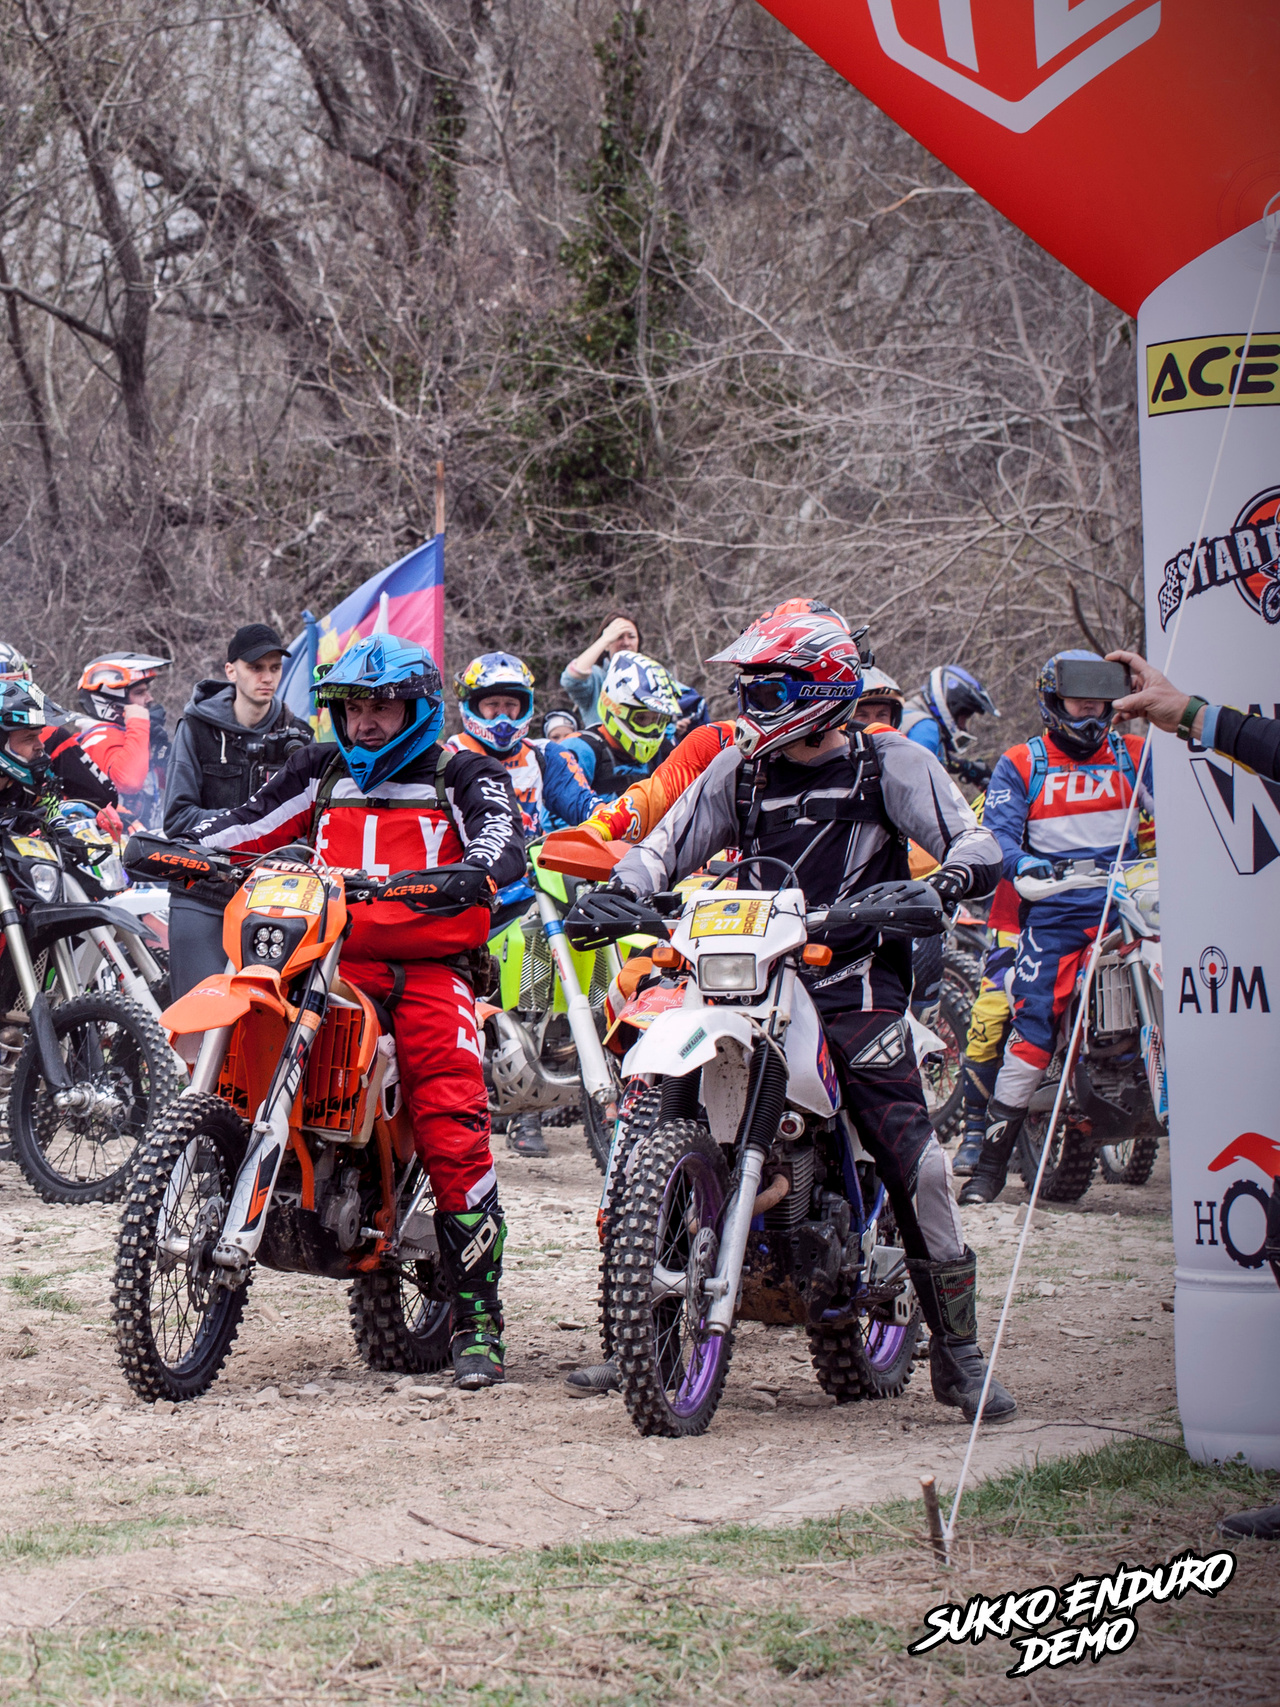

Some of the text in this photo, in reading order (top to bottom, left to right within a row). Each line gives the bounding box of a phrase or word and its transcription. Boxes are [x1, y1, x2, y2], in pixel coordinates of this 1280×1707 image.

[799, 684, 856, 697] NENKI
[1043, 768, 1116, 806] FOX
[148, 851, 211, 871] ACERBIS
[269, 861, 360, 876] RENTHAL
[271, 891, 299, 904] 275
[300, 879, 319, 910] BRONZE
[383, 883, 438, 898] ACERBIS
[713, 917, 742, 930] 277
[743, 901, 761, 934] BRONZE
[458, 1213, 499, 1271] SIDI
